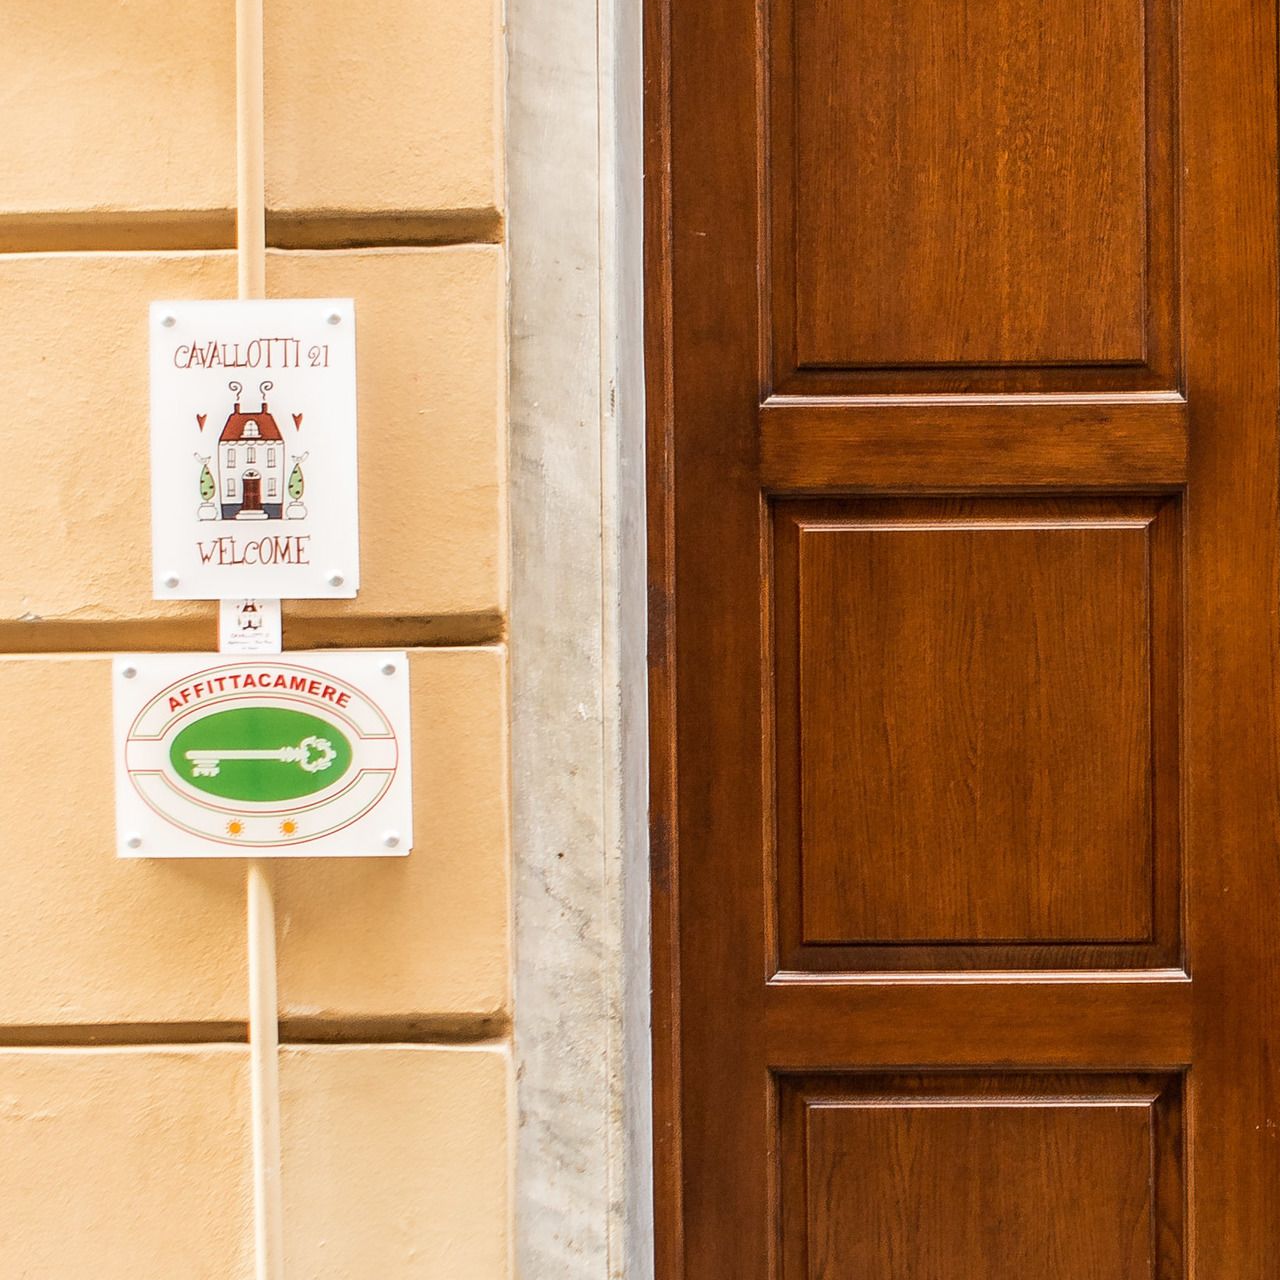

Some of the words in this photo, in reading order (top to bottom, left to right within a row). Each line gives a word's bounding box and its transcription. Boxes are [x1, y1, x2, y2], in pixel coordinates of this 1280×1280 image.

[173, 337, 301, 369] CAVALLOTTI
[307, 344, 330, 368] 21
[195, 535, 311, 566] WELCOME
[168, 673, 352, 713] AFFITTACAMERE
